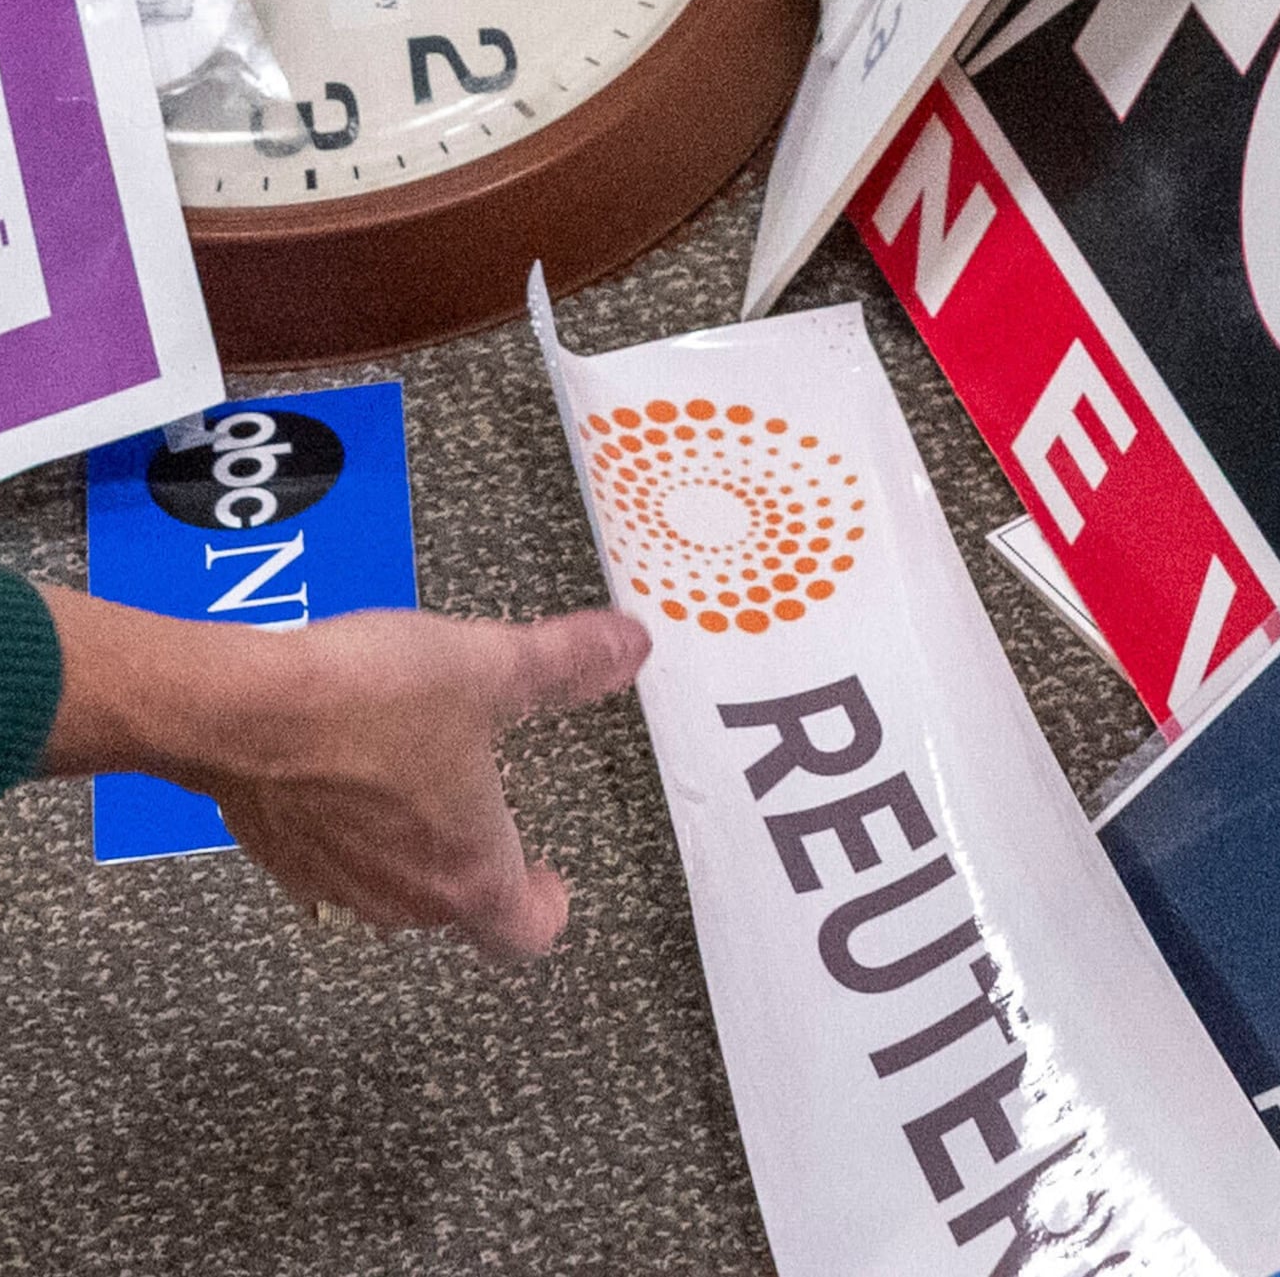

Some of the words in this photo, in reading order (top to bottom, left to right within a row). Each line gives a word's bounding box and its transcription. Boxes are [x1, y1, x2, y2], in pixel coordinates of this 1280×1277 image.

[407, 27, 518, 104] 2
[250, 82, 360, 158] 3
[212, 412, 292, 529] abc
